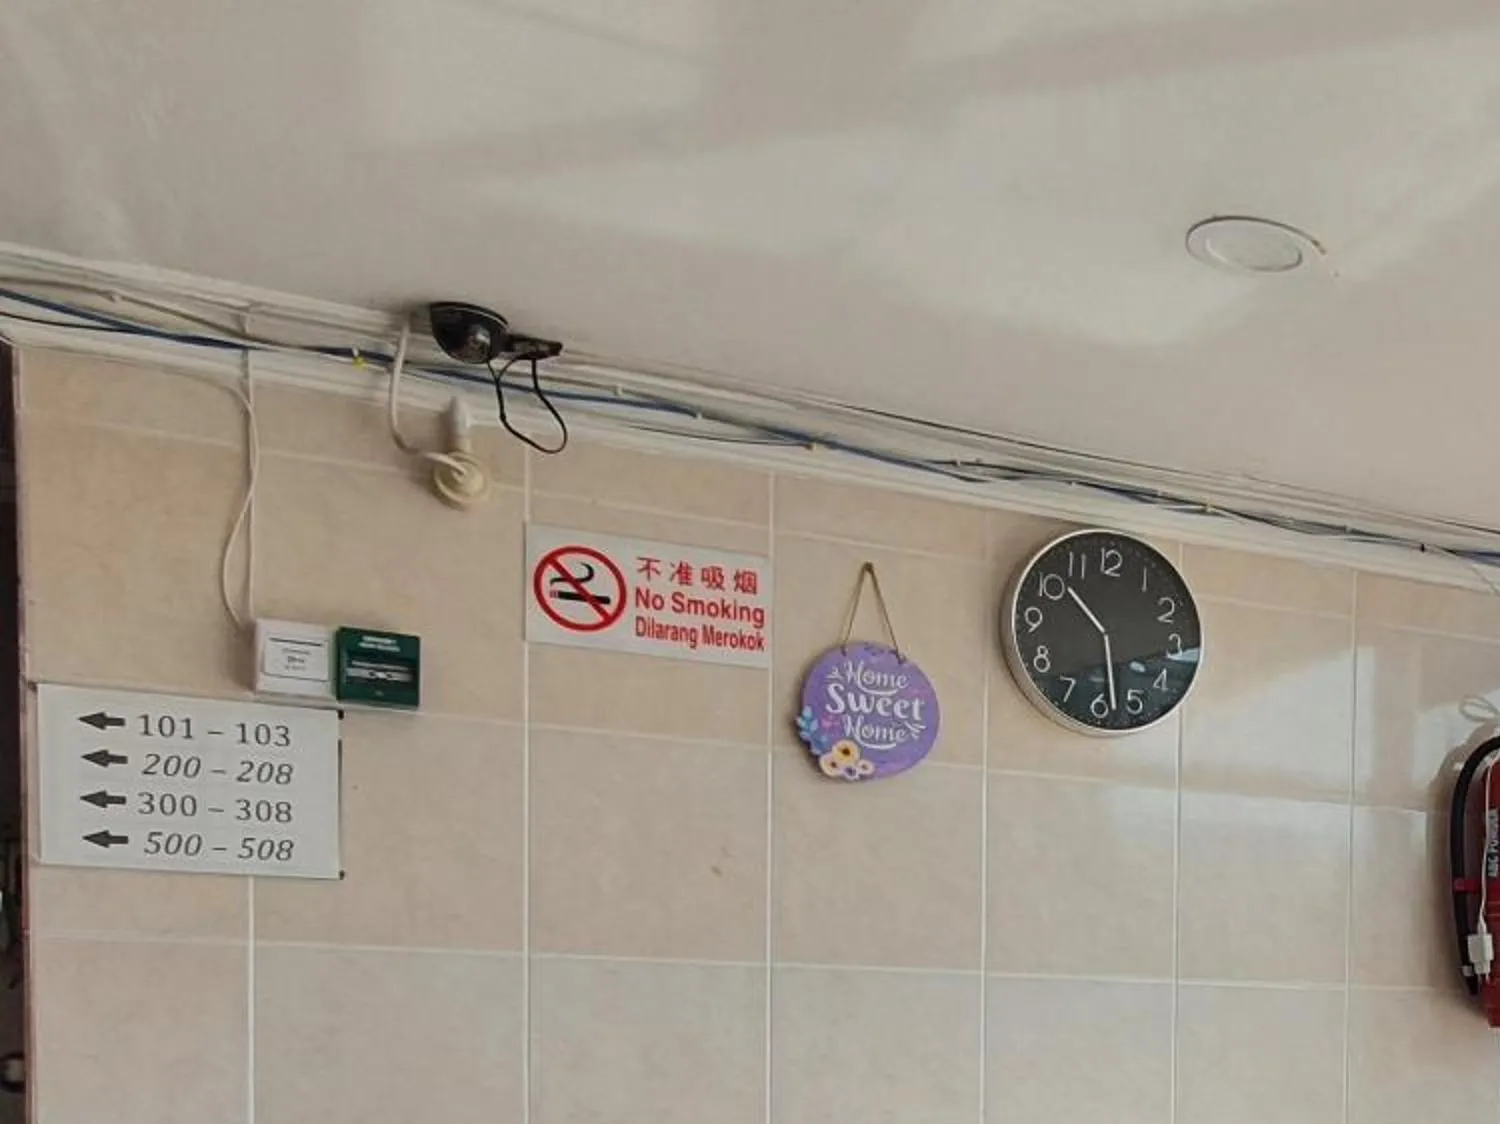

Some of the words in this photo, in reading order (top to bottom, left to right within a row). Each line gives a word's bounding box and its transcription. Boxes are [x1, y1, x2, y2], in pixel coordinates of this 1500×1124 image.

[636, 555, 758, 596] 不准吸烟
[1069, 551, 1086, 580] 11
[1101, 548, 1123, 577] 12
[1039, 572, 1065, 600] 10
[635, 587, 664, 611] No
[672, 592, 766, 629] Smoking
[1024, 607, 1043, 632] 9
[1157, 597, 1175, 623] 2
[635, 616, 697, 649] Dilarang
[702, 628, 766, 652] Merokok
[1167, 633, 1183, 660] 3
[1033, 645, 1051, 673] 8
[844, 661, 908, 689] Home
[1059, 676, 1077, 703] 7
[1153, 668, 1168, 692] 4
[826, 684, 926, 721] Sweet
[1090, 693, 1109, 718] 6
[1126, 689, 1144, 715] 5
[137, 714, 194, 739] 101
[235, 722, 291, 748] 103
[844, 714, 909, 743] Home
[141, 753, 201, 779] 200
[236, 761, 293, 785] 208
[137, 792, 197, 817] 300
[235, 799, 292, 824] 308
[144, 832, 202, 857] 500
[238, 838, 294, 862] 508
